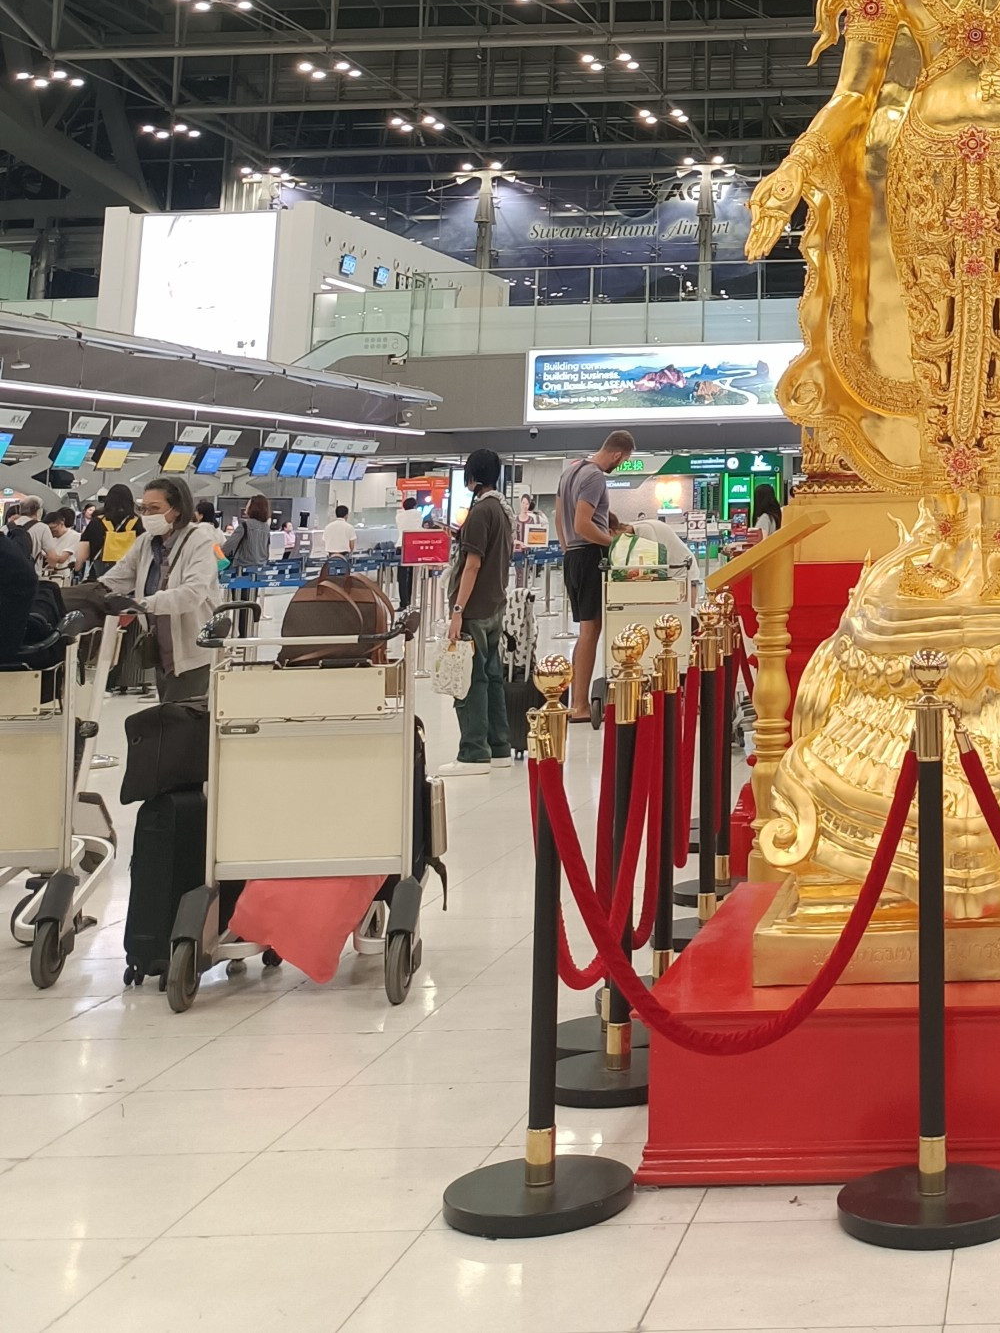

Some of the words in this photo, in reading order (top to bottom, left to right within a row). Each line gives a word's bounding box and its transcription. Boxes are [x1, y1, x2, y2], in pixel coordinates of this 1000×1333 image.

[530, 221, 658, 239] Suvarnabhumi
[544, 362, 579, 371] Building
[543, 371, 579, 381] building
[581, 372, 620, 380] business.
[543, 382, 562, 391] One
[10, 415, 25, 424] K14
[731, 484, 748, 493] ATM
